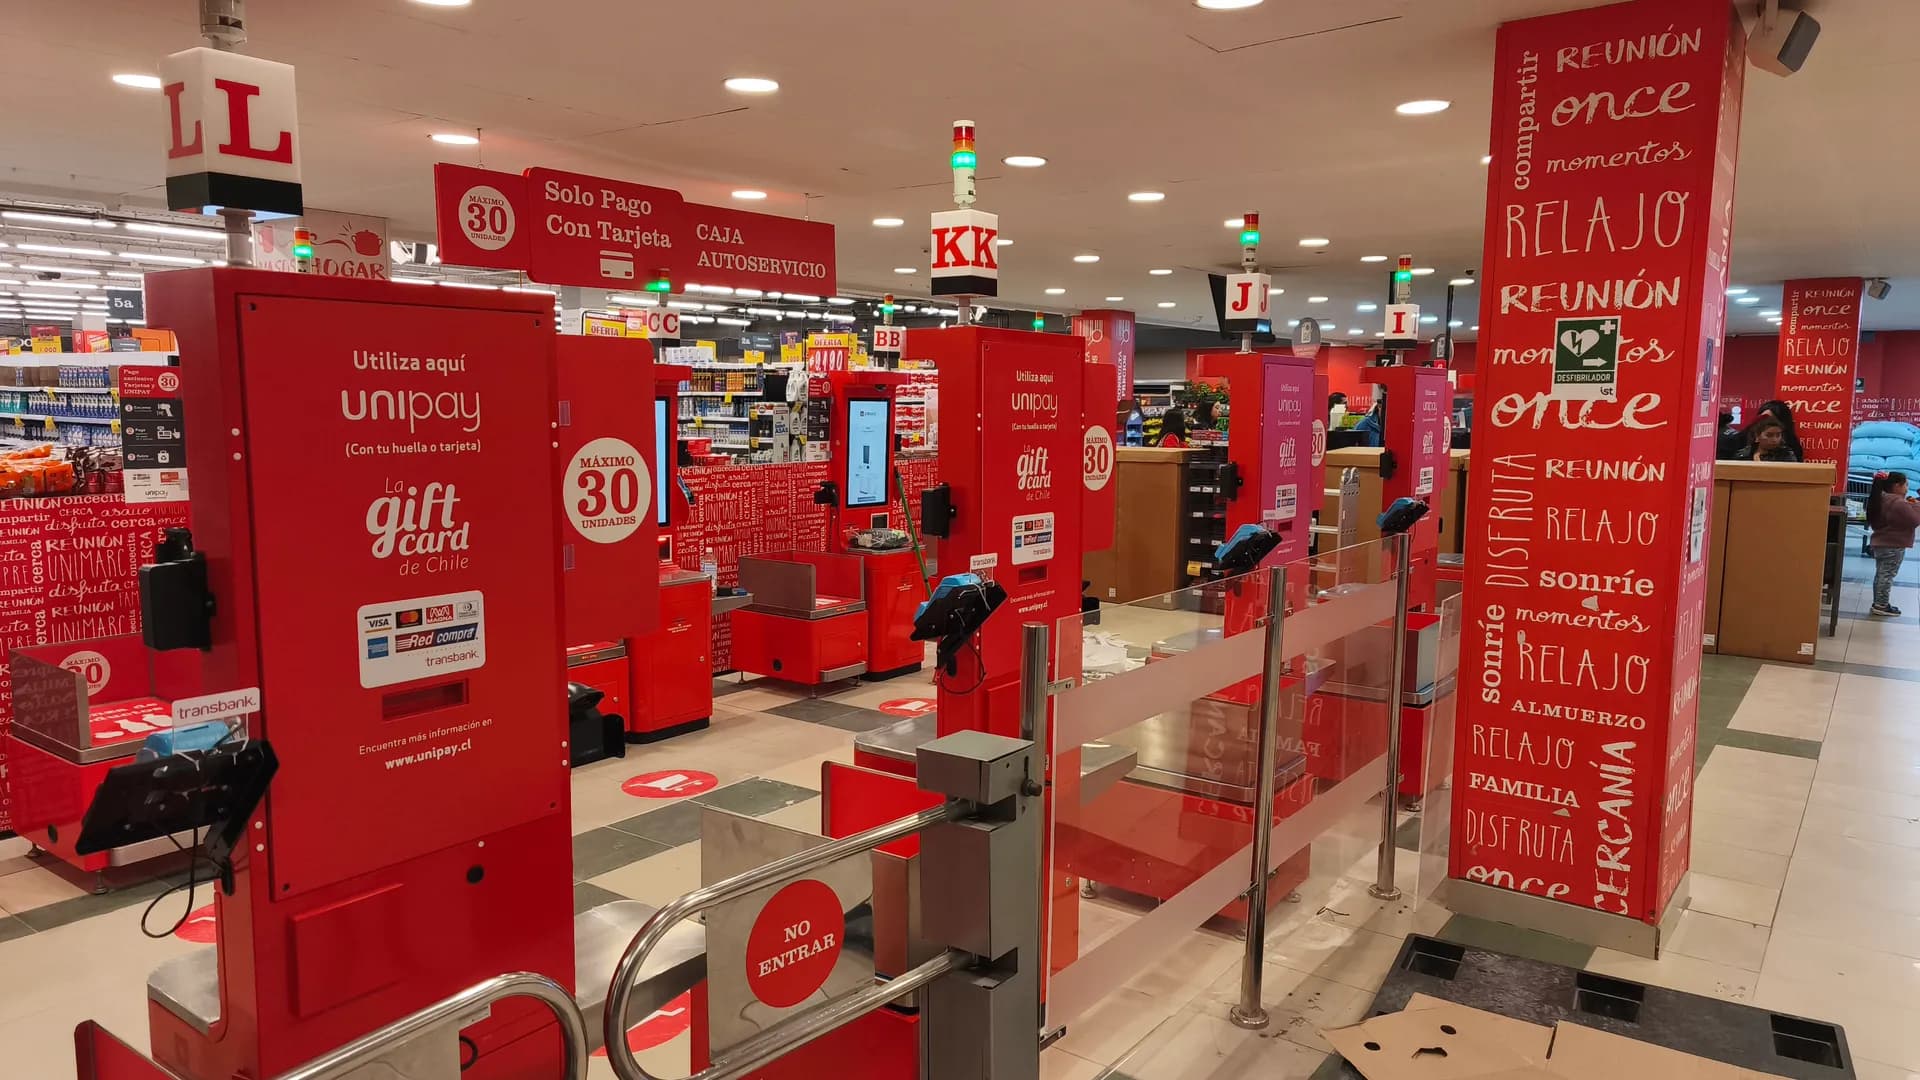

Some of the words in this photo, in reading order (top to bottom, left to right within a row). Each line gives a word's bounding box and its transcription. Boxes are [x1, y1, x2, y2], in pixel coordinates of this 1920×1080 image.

[1556, 24, 1701, 72] REUNIÓN
[1551, 81, 1696, 127] once
[164, 82, 203, 159] L
[215, 78, 293, 164] L
[1514, 51, 1540, 190] compartir
[1546, 141, 1692, 173] momentos
[545, 180, 595, 207] Solo
[600, 189, 652, 217] Pago
[467, 202, 507, 235] 30
[546, 214, 591, 239] Con
[597, 223, 672, 249] Tarjeta
[1506, 190, 1690, 258] RELAJO
[470, 232, 506, 241] UNIDADES
[696, 224, 744, 246] CAJA
[932, 226, 969, 269] K
[971, 226, 997, 269] K
[311, 257, 386, 279] HOGAR
[697, 251, 827, 278] AUTOSERVICIO
[114, 297, 134, 309] 5a
[1232, 282, 1252, 311] J
[1260, 284, 1269, 312] J
[1501, 268, 1680, 314] REUNIÓN
[1805, 287, 1855, 298] REUNIÓN
[648, 313, 660, 333] C
[662, 313, 679, 334] C
[1392, 312, 1406, 333] I
[1803, 304, 1851, 316] once
[875, 331, 888, 347] B
[889, 331, 900, 347] B
[1801, 322, 1851, 331] momentos
[1786, 338, 1850, 357] RELAJO
[353, 349, 421, 371] Utiliza
[426, 354, 466, 377] aquí
[1016, 370, 1039, 382] Utiliza
[1039, 371, 1054, 383] aquí
[1783, 361, 1847, 375] REUNIÓN
[161, 377, 176, 387] 30
[1557, 373, 1611, 382] DESFIBRILADOR
[1781, 382, 1844, 392] momentos
[341, 389, 481, 434] unipay
[1011, 392, 1058, 418] unipay
[1491, 391, 1668, 430] once
[1800, 418, 1842, 430] REUNIÓN
[346, 442, 374, 458] (Con
[377, 443, 390, 455] tu
[392, 441, 428, 454] huella
[430, 443, 437, 453] o
[440, 439, 481, 455] tarjeta)
[579, 455, 635, 469] MÁXIMO
[1084, 444, 1109, 474] 30
[1016, 446, 1049, 490] gift
[1027, 470, 1051, 489] card
[1545, 455, 1666, 482] REUNIÓN
[385, 477, 404, 494] La
[577, 468, 639, 516] 30
[59, 507, 93, 517] CERCA
[111, 517, 157, 529] cerca
[365, 481, 461, 559] gift
[581, 515, 636, 529] UNIDADES
[1485, 453, 1537, 587] DISFRUTA
[45, 516, 107, 537] disfruta
[398, 522, 470, 556] card
[1546, 507, 1660, 545] RELAJO
[46, 531, 124, 552] REUNIÓN
[31, 539, 44, 584] cerca
[48, 548, 127, 582] UNIMARC
[400, 558, 420, 575] de
[427, 555, 469, 573] Chile
[49, 579, 120, 602] disfruta
[1539, 569, 1655, 597] sonríe
[52, 601, 114, 618] REUNIÓN
[368, 618, 390, 628] VISA
[1515, 607, 1651, 633] momentos
[408, 632, 434, 648] Red
[437, 627, 475, 644] compra
[1477, 604, 1505, 704] sonríe
[1518, 642, 1651, 695] RELAJO
[177, 695, 257, 720] transbank.
[1511, 699, 1646, 730] ALMUERZO
[359, 737, 407, 755] Encuentra
[408, 731, 427, 743] más
[429, 719, 480, 740] información
[482, 718, 493, 727] en
[1473, 724, 1575, 770] RELAJO
[385, 738, 472, 770] www.unipay.cl
[1469, 772, 1580, 808] FAMILIA
[1466, 808, 1574, 865] DISFRUTA
[1588, 741, 1637, 915] CERCANÍA
[783, 919, 811, 943] NO
[758, 933, 836, 978] ENTRAR
